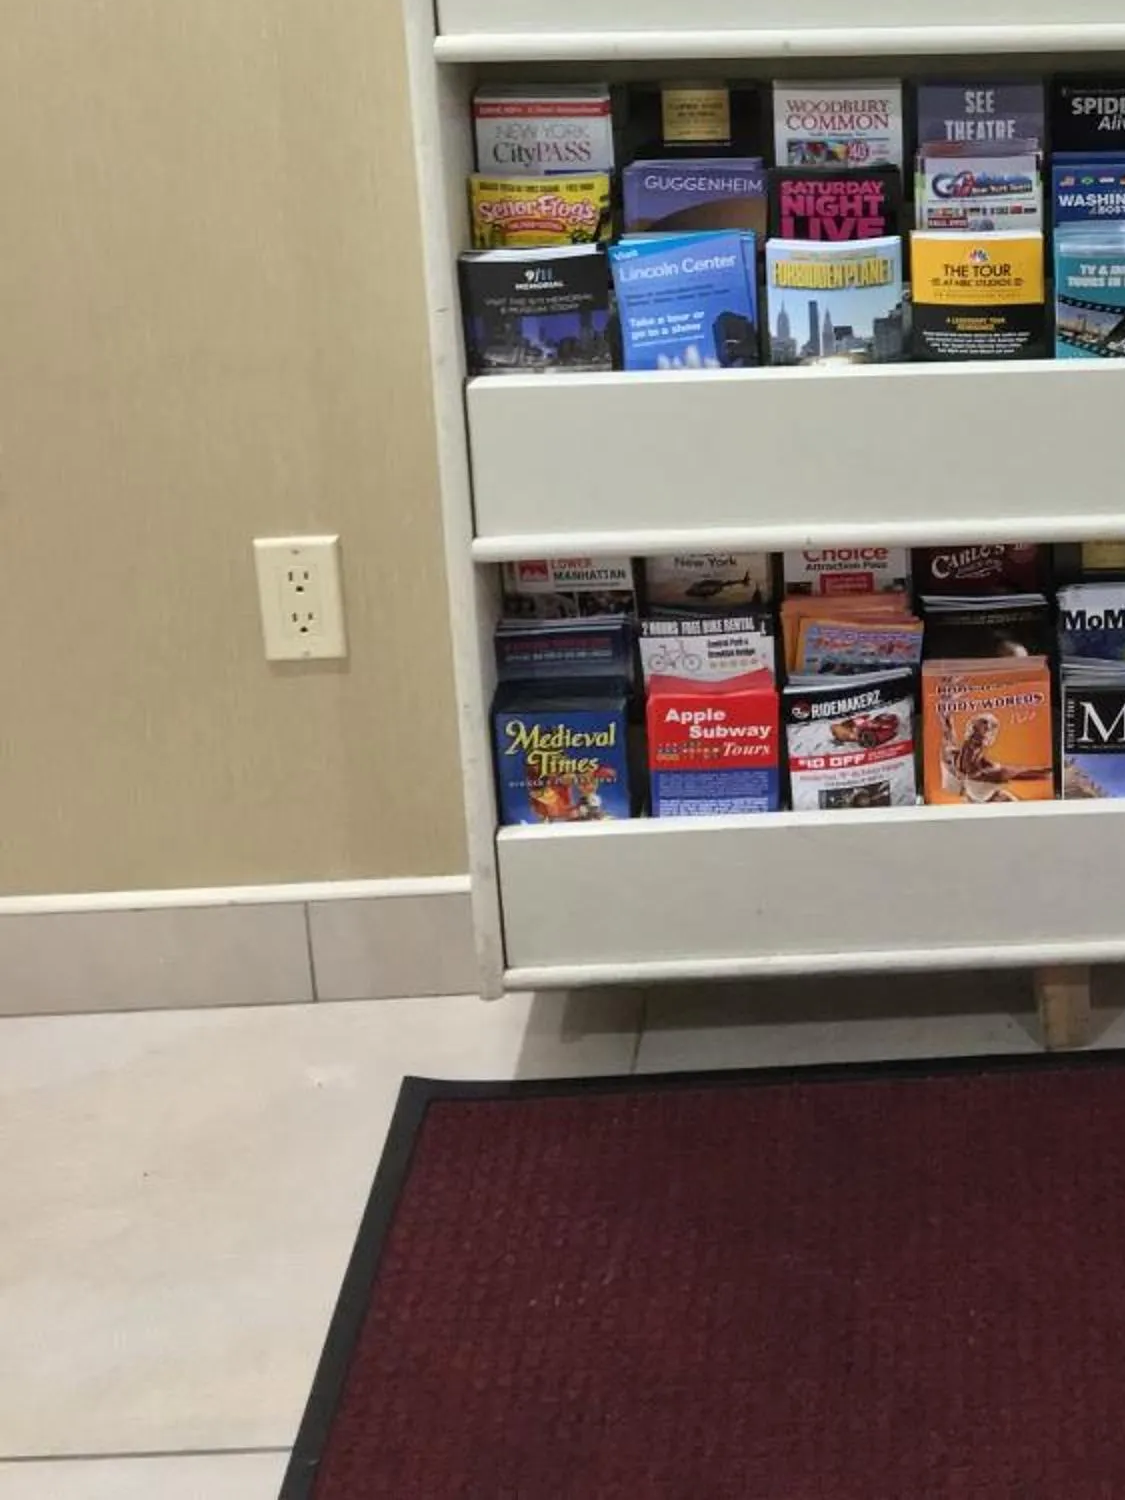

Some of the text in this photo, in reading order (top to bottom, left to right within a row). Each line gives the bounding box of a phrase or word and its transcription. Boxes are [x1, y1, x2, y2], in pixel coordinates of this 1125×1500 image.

[786, 100, 889, 113] WOODBURY
[965, 90, 995, 113] SEE
[786, 114, 889, 129] COMMON
[496, 123, 590, 139] NEW YORK
[945, 120, 1016, 140] THEATRE
[493, 142, 591, 167] CityPASS
[645, 175, 763, 193] GUGGENHEIM
[781, 180, 884, 194] SATURDAY
[780, 196, 885, 217] NIGHT
[780, 218, 885, 241] LIVE
[620, 256, 737, 282] Lincoln Center
[943, 263, 1012, 277] THE TOUR
[1080, 264, 1095, 275] TV
[515, 281, 564, 290] MEMORIAL
[674, 554, 737, 569] New York
[553, 569, 626, 581] MANHATTAN
[724, 618, 754, 631] RENTAL
[811, 690, 881, 718] RIDEMAKERZ
[936, 692, 1044, 713] BODY WORLDS
[665, 708, 727, 725] Apple
[505, 720, 616, 756] Medieval
[689, 725, 771, 740] Subway
[723, 742, 770, 757] Tours
[526, 751, 599, 778] Times
[830, 753, 865, 768] OFF
